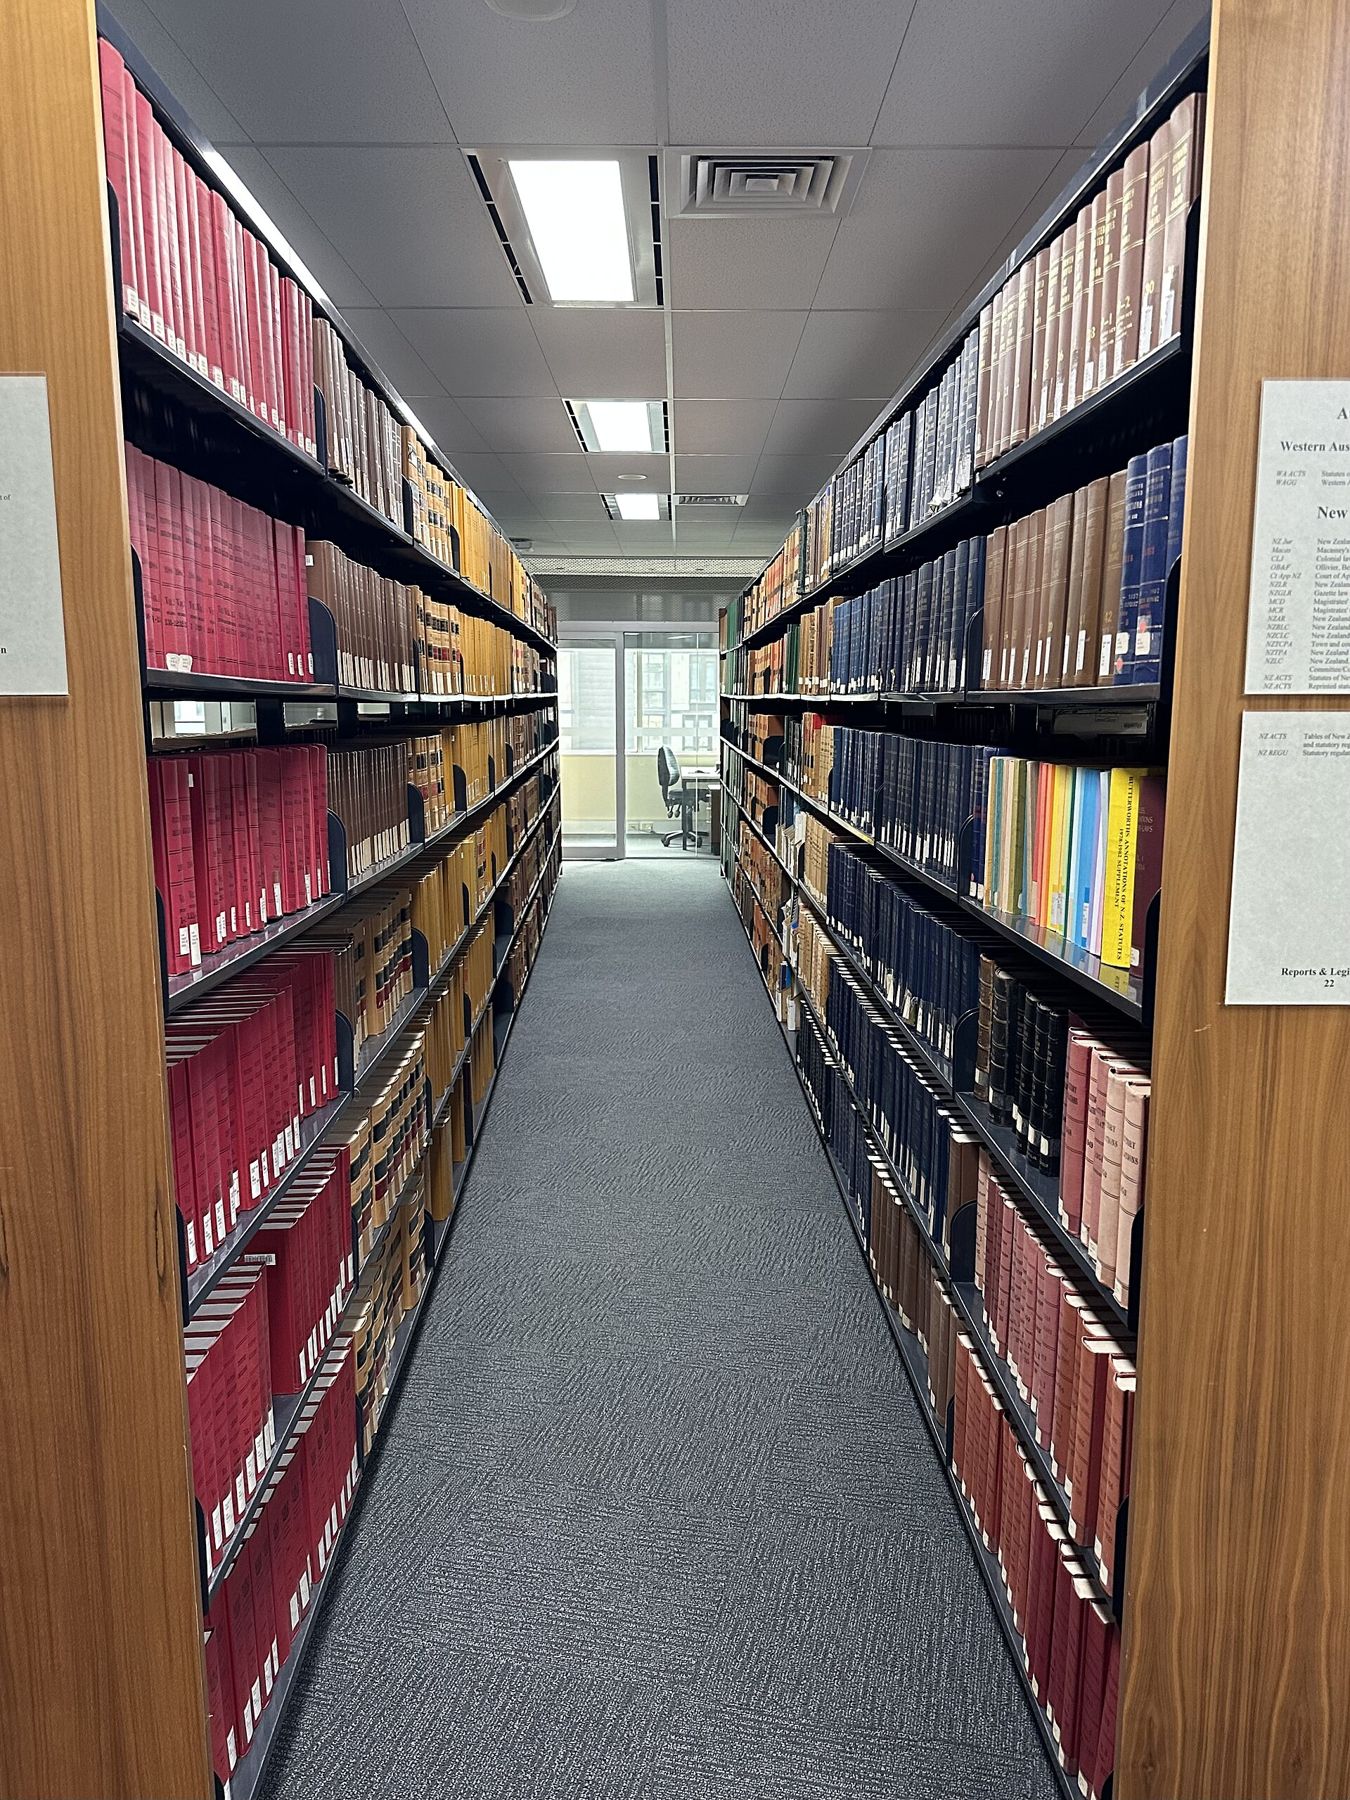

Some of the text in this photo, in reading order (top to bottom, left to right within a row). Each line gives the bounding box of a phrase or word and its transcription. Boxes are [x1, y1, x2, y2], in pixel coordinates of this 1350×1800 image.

[1337, 407, 1350, 419] A
[1280, 441, 1325, 451] Western
[1317, 506, 1347, 519] New
[1125, 776, 1133, 836] BUTTERWORTHS
[1281, 968, 1316, 978] Reports
